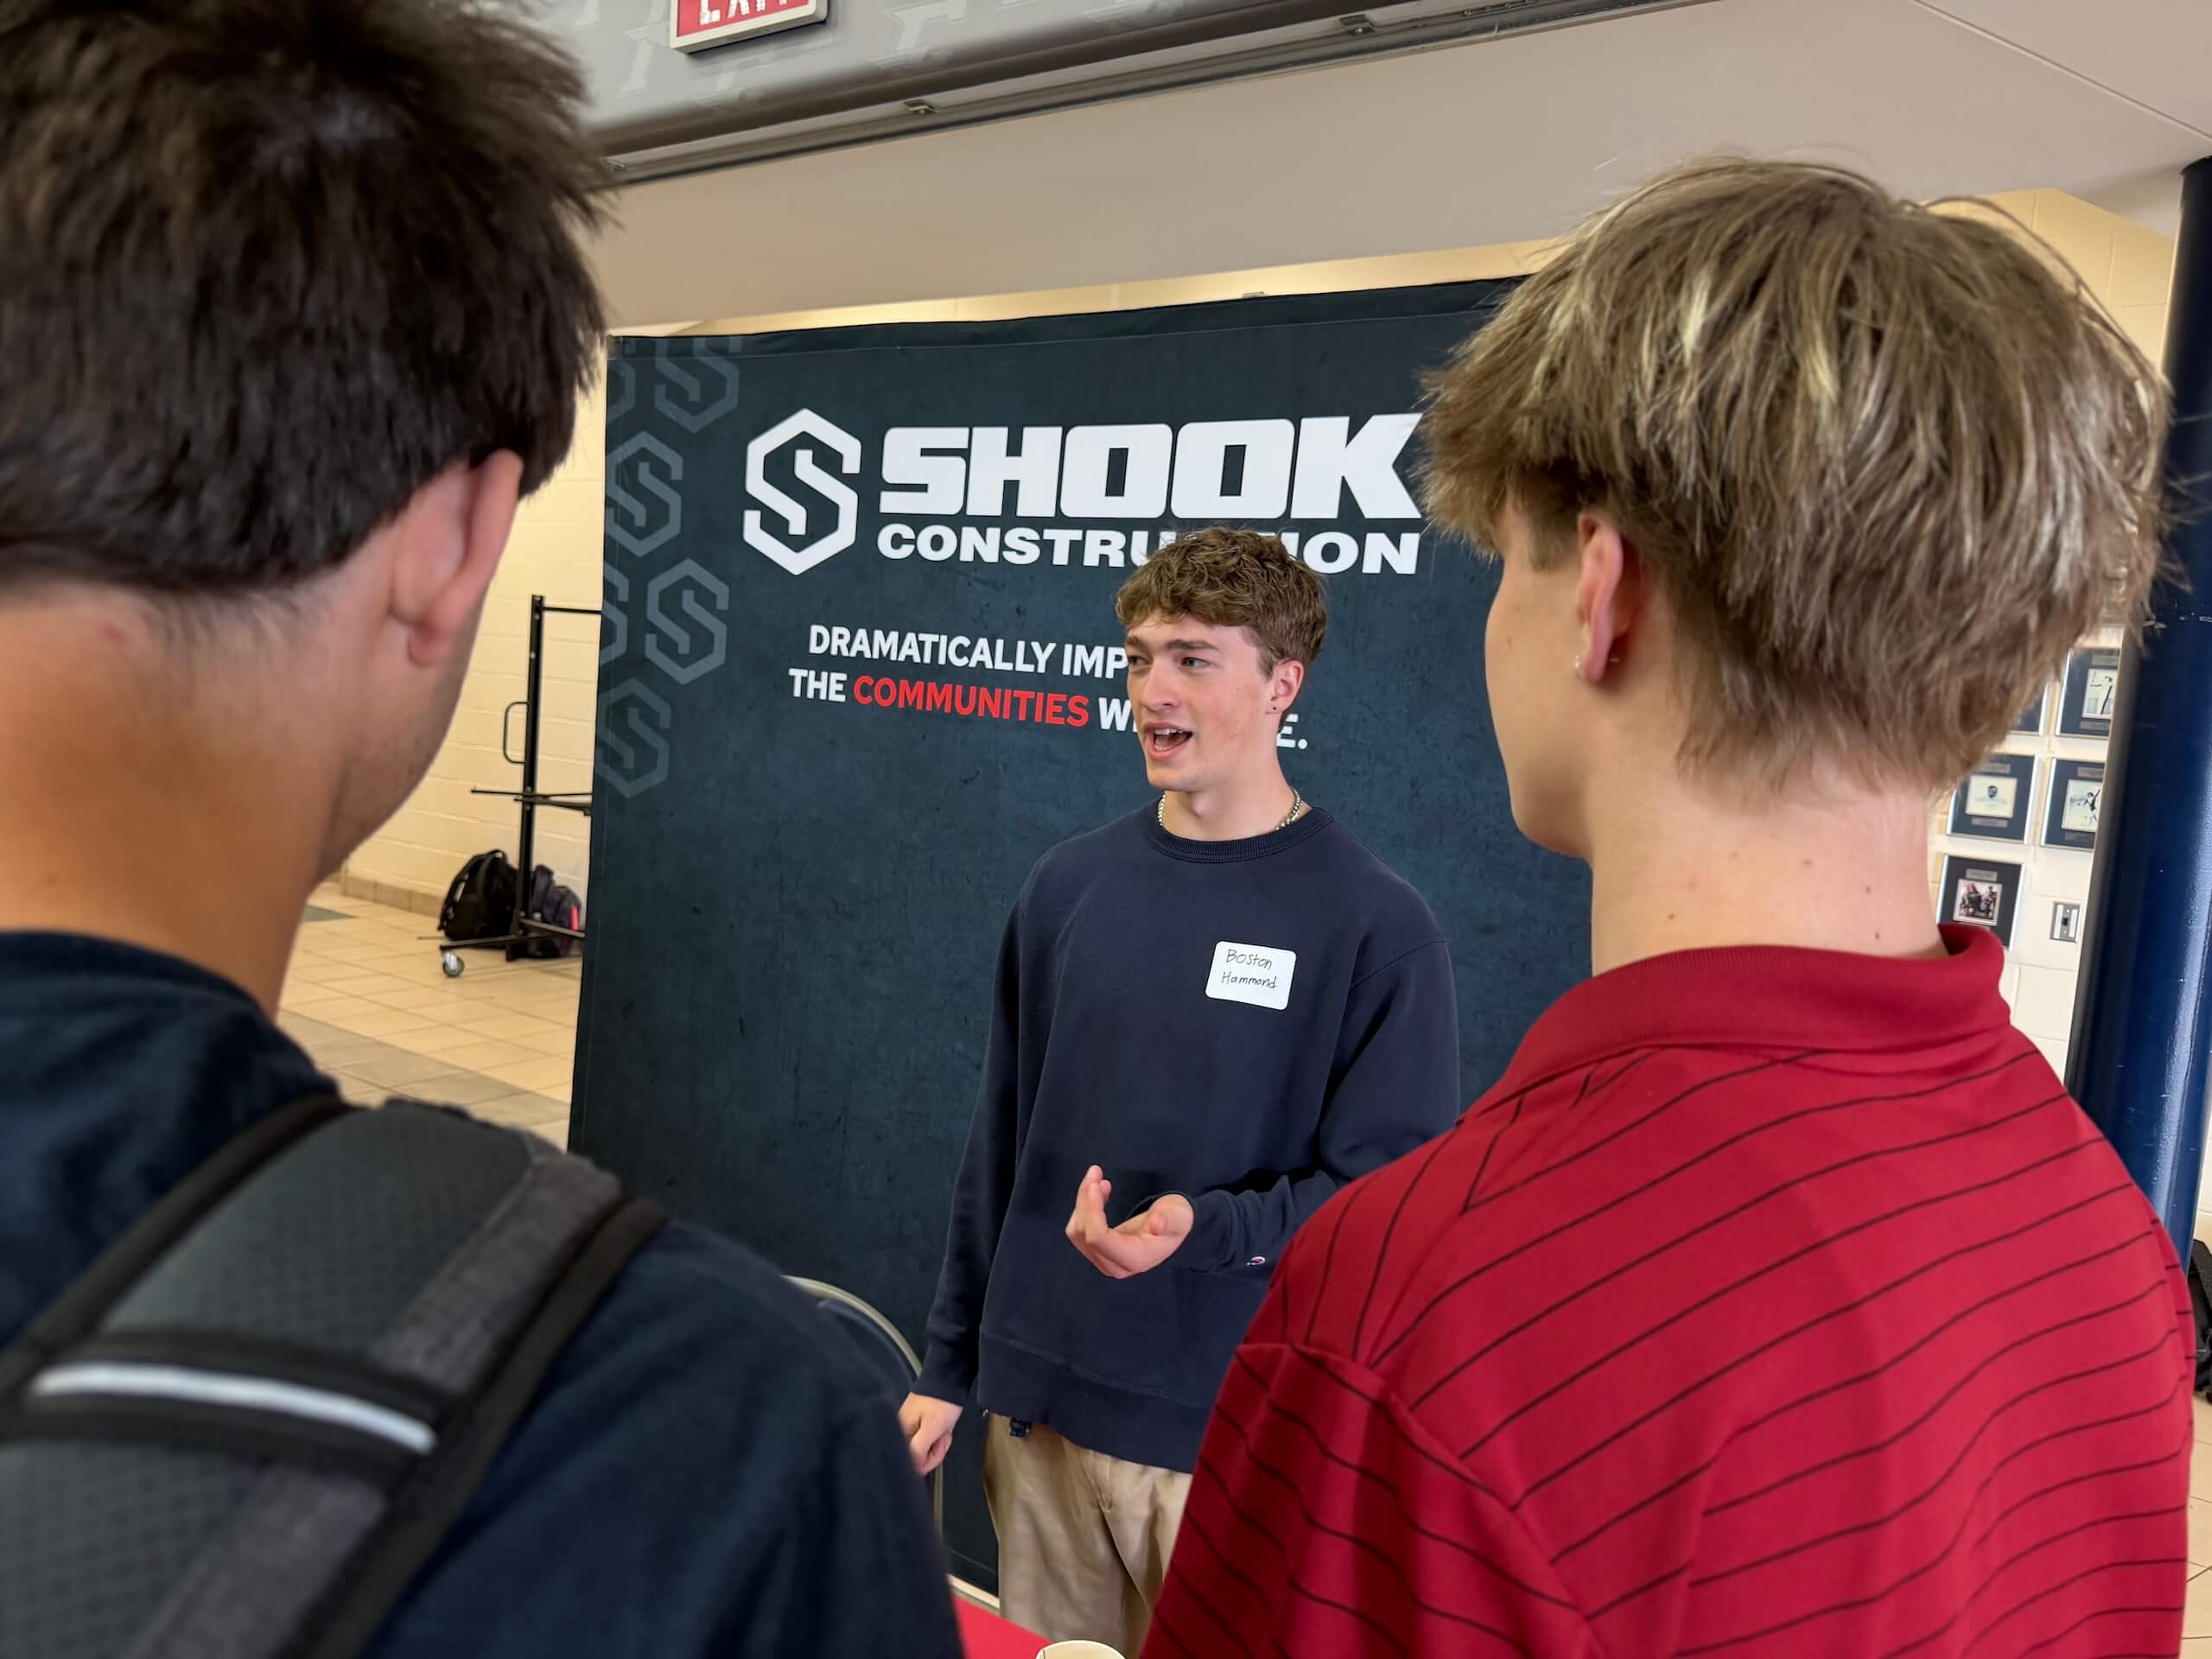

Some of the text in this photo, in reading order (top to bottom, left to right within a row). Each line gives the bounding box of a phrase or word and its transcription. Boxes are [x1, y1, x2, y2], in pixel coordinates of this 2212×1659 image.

[880, 412, 1422, 519] SHOOK
[809, 625, 1057, 675] DRAMATICALLY
[788, 668, 848, 702] THE
[853, 675, 1090, 728] COMMUNITIES
[1221, 971, 1277, 988] Hammond
[1226, 949, 1272, 969] Boston
